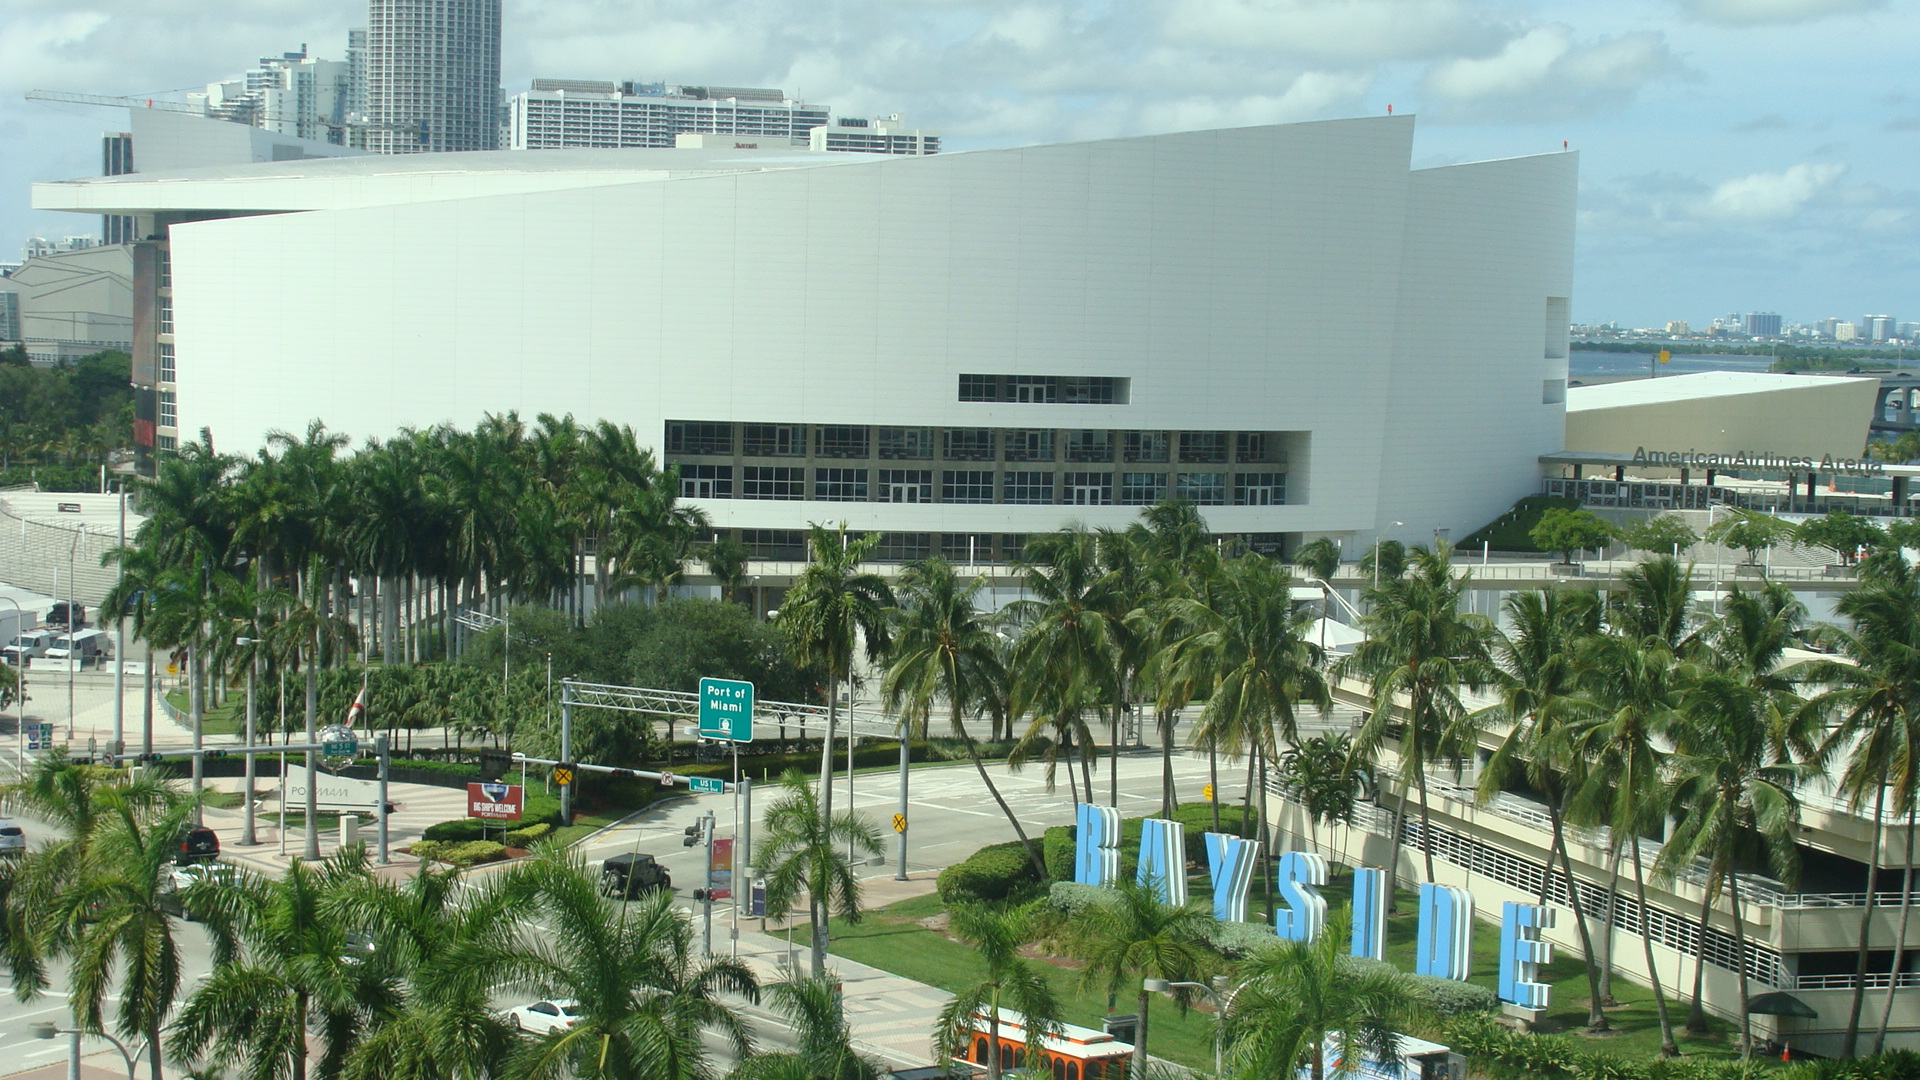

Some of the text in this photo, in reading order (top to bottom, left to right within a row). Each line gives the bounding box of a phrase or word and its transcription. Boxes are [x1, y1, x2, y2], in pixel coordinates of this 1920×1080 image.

[1820, 453, 1883, 476] Arena
[707, 685, 746, 699] Port of
[710, 699, 742, 713] Miami
[700, 779, 709, 787] US
[473, 802, 517, 814] BIG SHIPS WELCOME
[1075, 803, 1556, 1009] BAYSIDE
